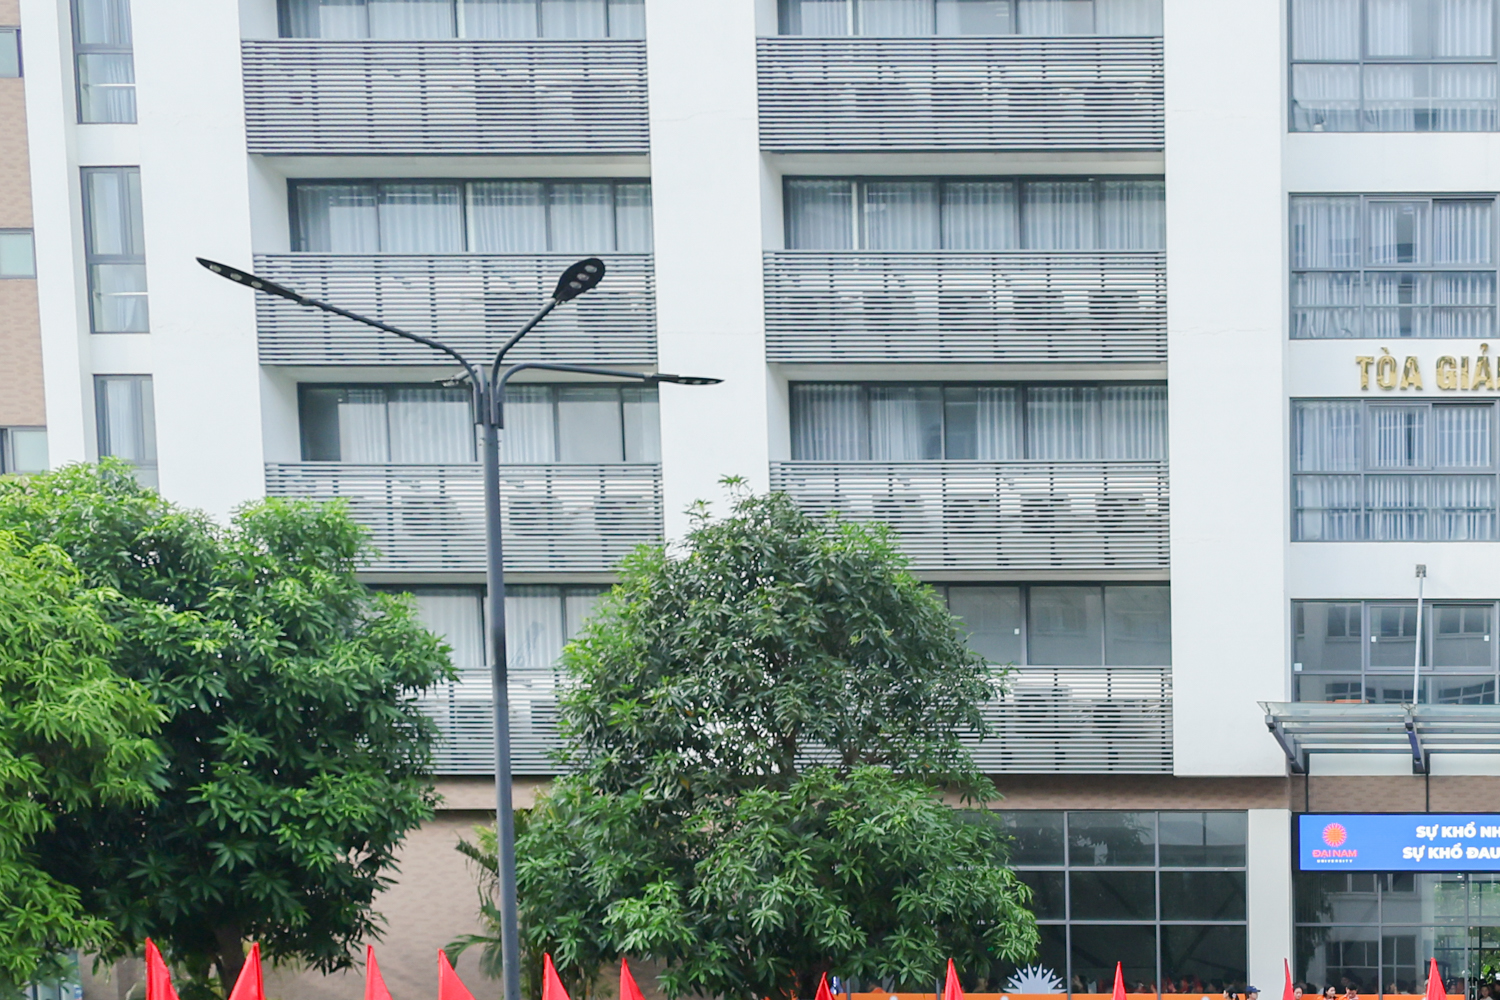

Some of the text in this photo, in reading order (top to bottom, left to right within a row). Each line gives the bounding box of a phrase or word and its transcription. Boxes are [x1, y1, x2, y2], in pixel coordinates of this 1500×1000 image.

[1355, 346, 1423, 391] TÒA
[1415, 824, 1439, 841] SỰ
[1441, 821, 1476, 838] KHỔ
[1332, 849, 1358, 857] NAM
[1402, 845, 1426, 862] SỰ
[1428, 843, 1463, 859] KHỔ
[1466, 846, 1500, 859] ĐAU
